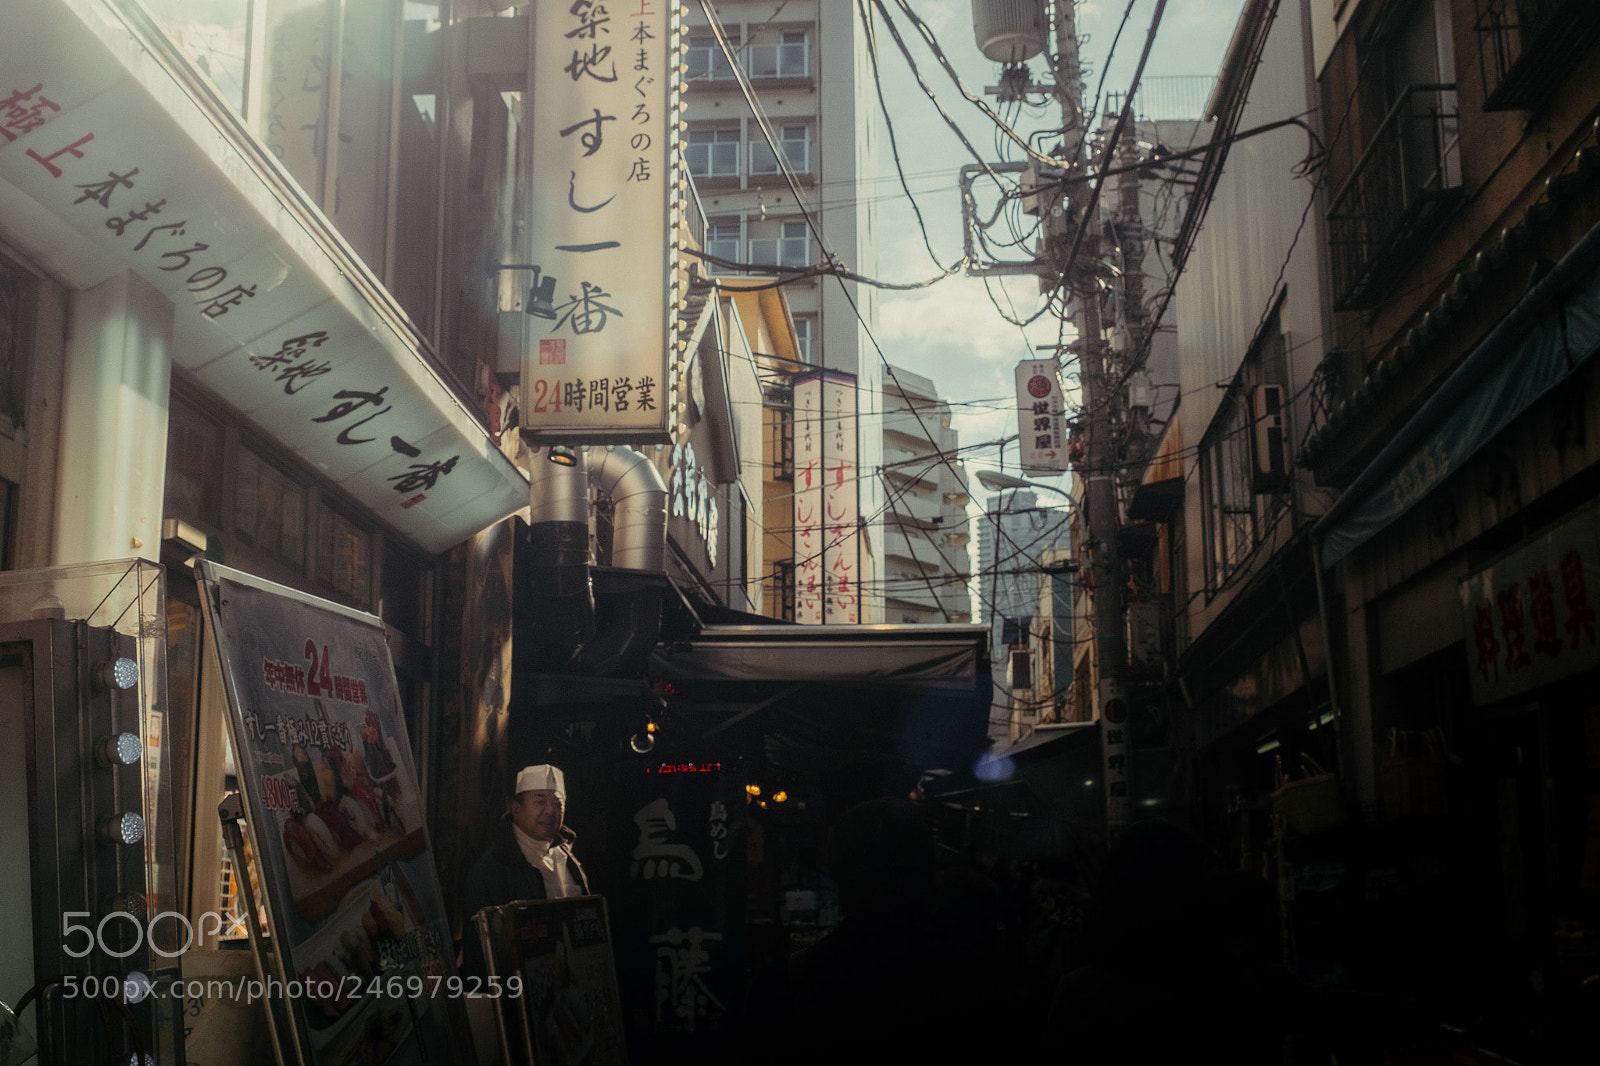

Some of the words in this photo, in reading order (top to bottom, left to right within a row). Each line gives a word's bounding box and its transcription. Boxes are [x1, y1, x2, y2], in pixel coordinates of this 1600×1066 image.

[0, 83, 257, 319] 極上本まぐろの店
[533, 376, 657, 413] 24時間営業
[1473, 549, 1597, 682] 料理道具
